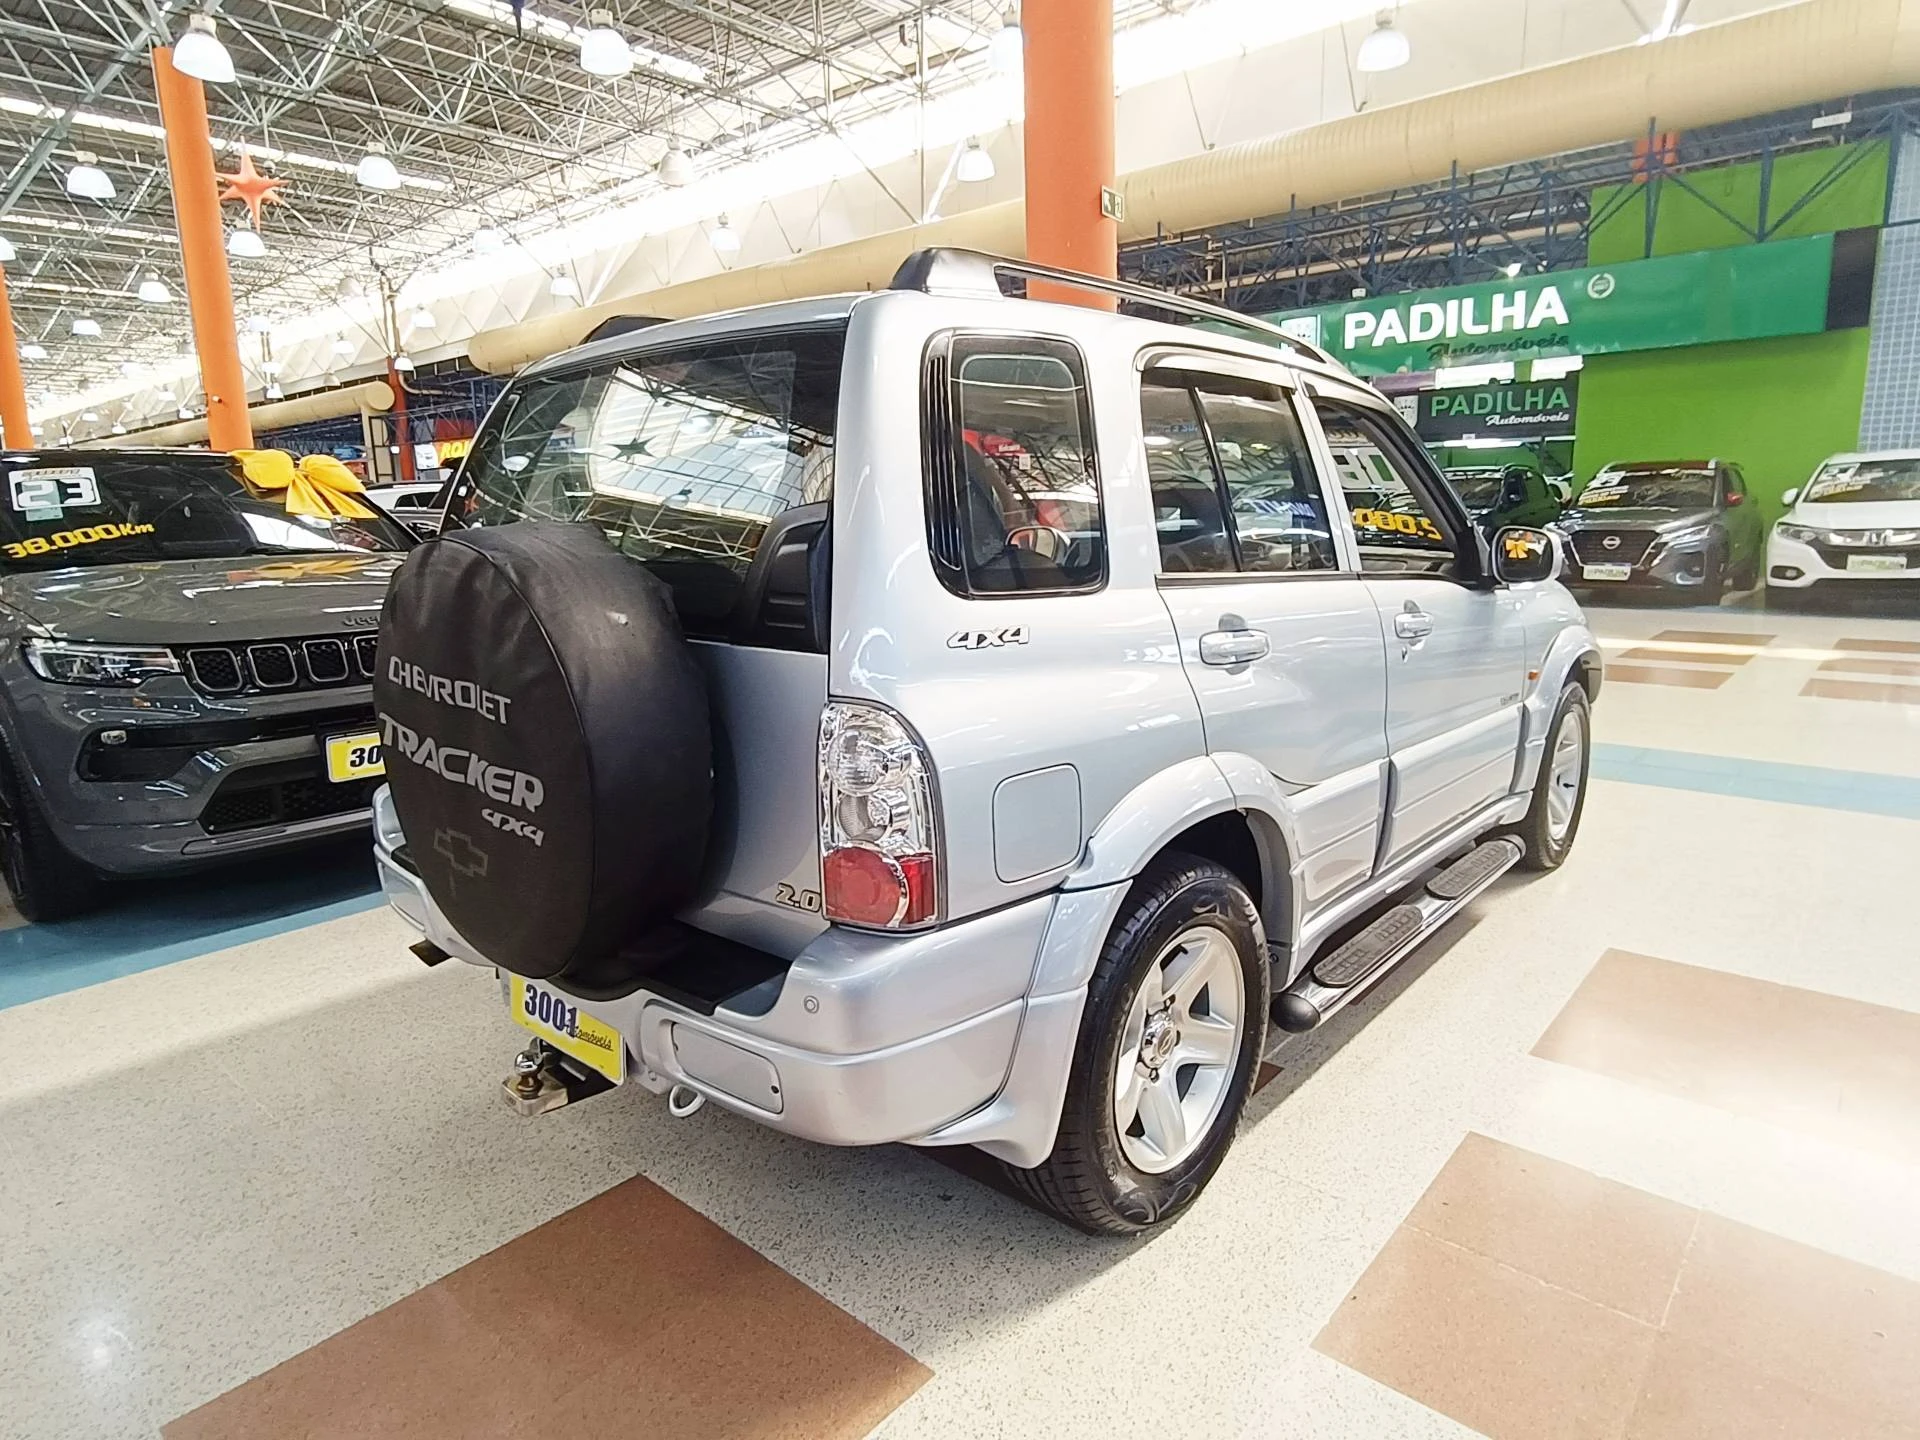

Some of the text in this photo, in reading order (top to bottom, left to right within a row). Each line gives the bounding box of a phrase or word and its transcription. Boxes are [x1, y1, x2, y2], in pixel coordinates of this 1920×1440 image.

[1344, 286, 1569, 350] PADILHA
[1426, 333, 1569, 361] Automóveis
[1431, 386, 1570, 417] PADILHA
[1485, 412, 1570, 426] Automóveis
[17, 478, 96, 508] 23
[388, 655, 511, 725] CHEVROLET
[378, 712, 544, 812] TRACKER
[776, 883, 821, 913] 2.0
[525, 983, 578, 1038] 3001
